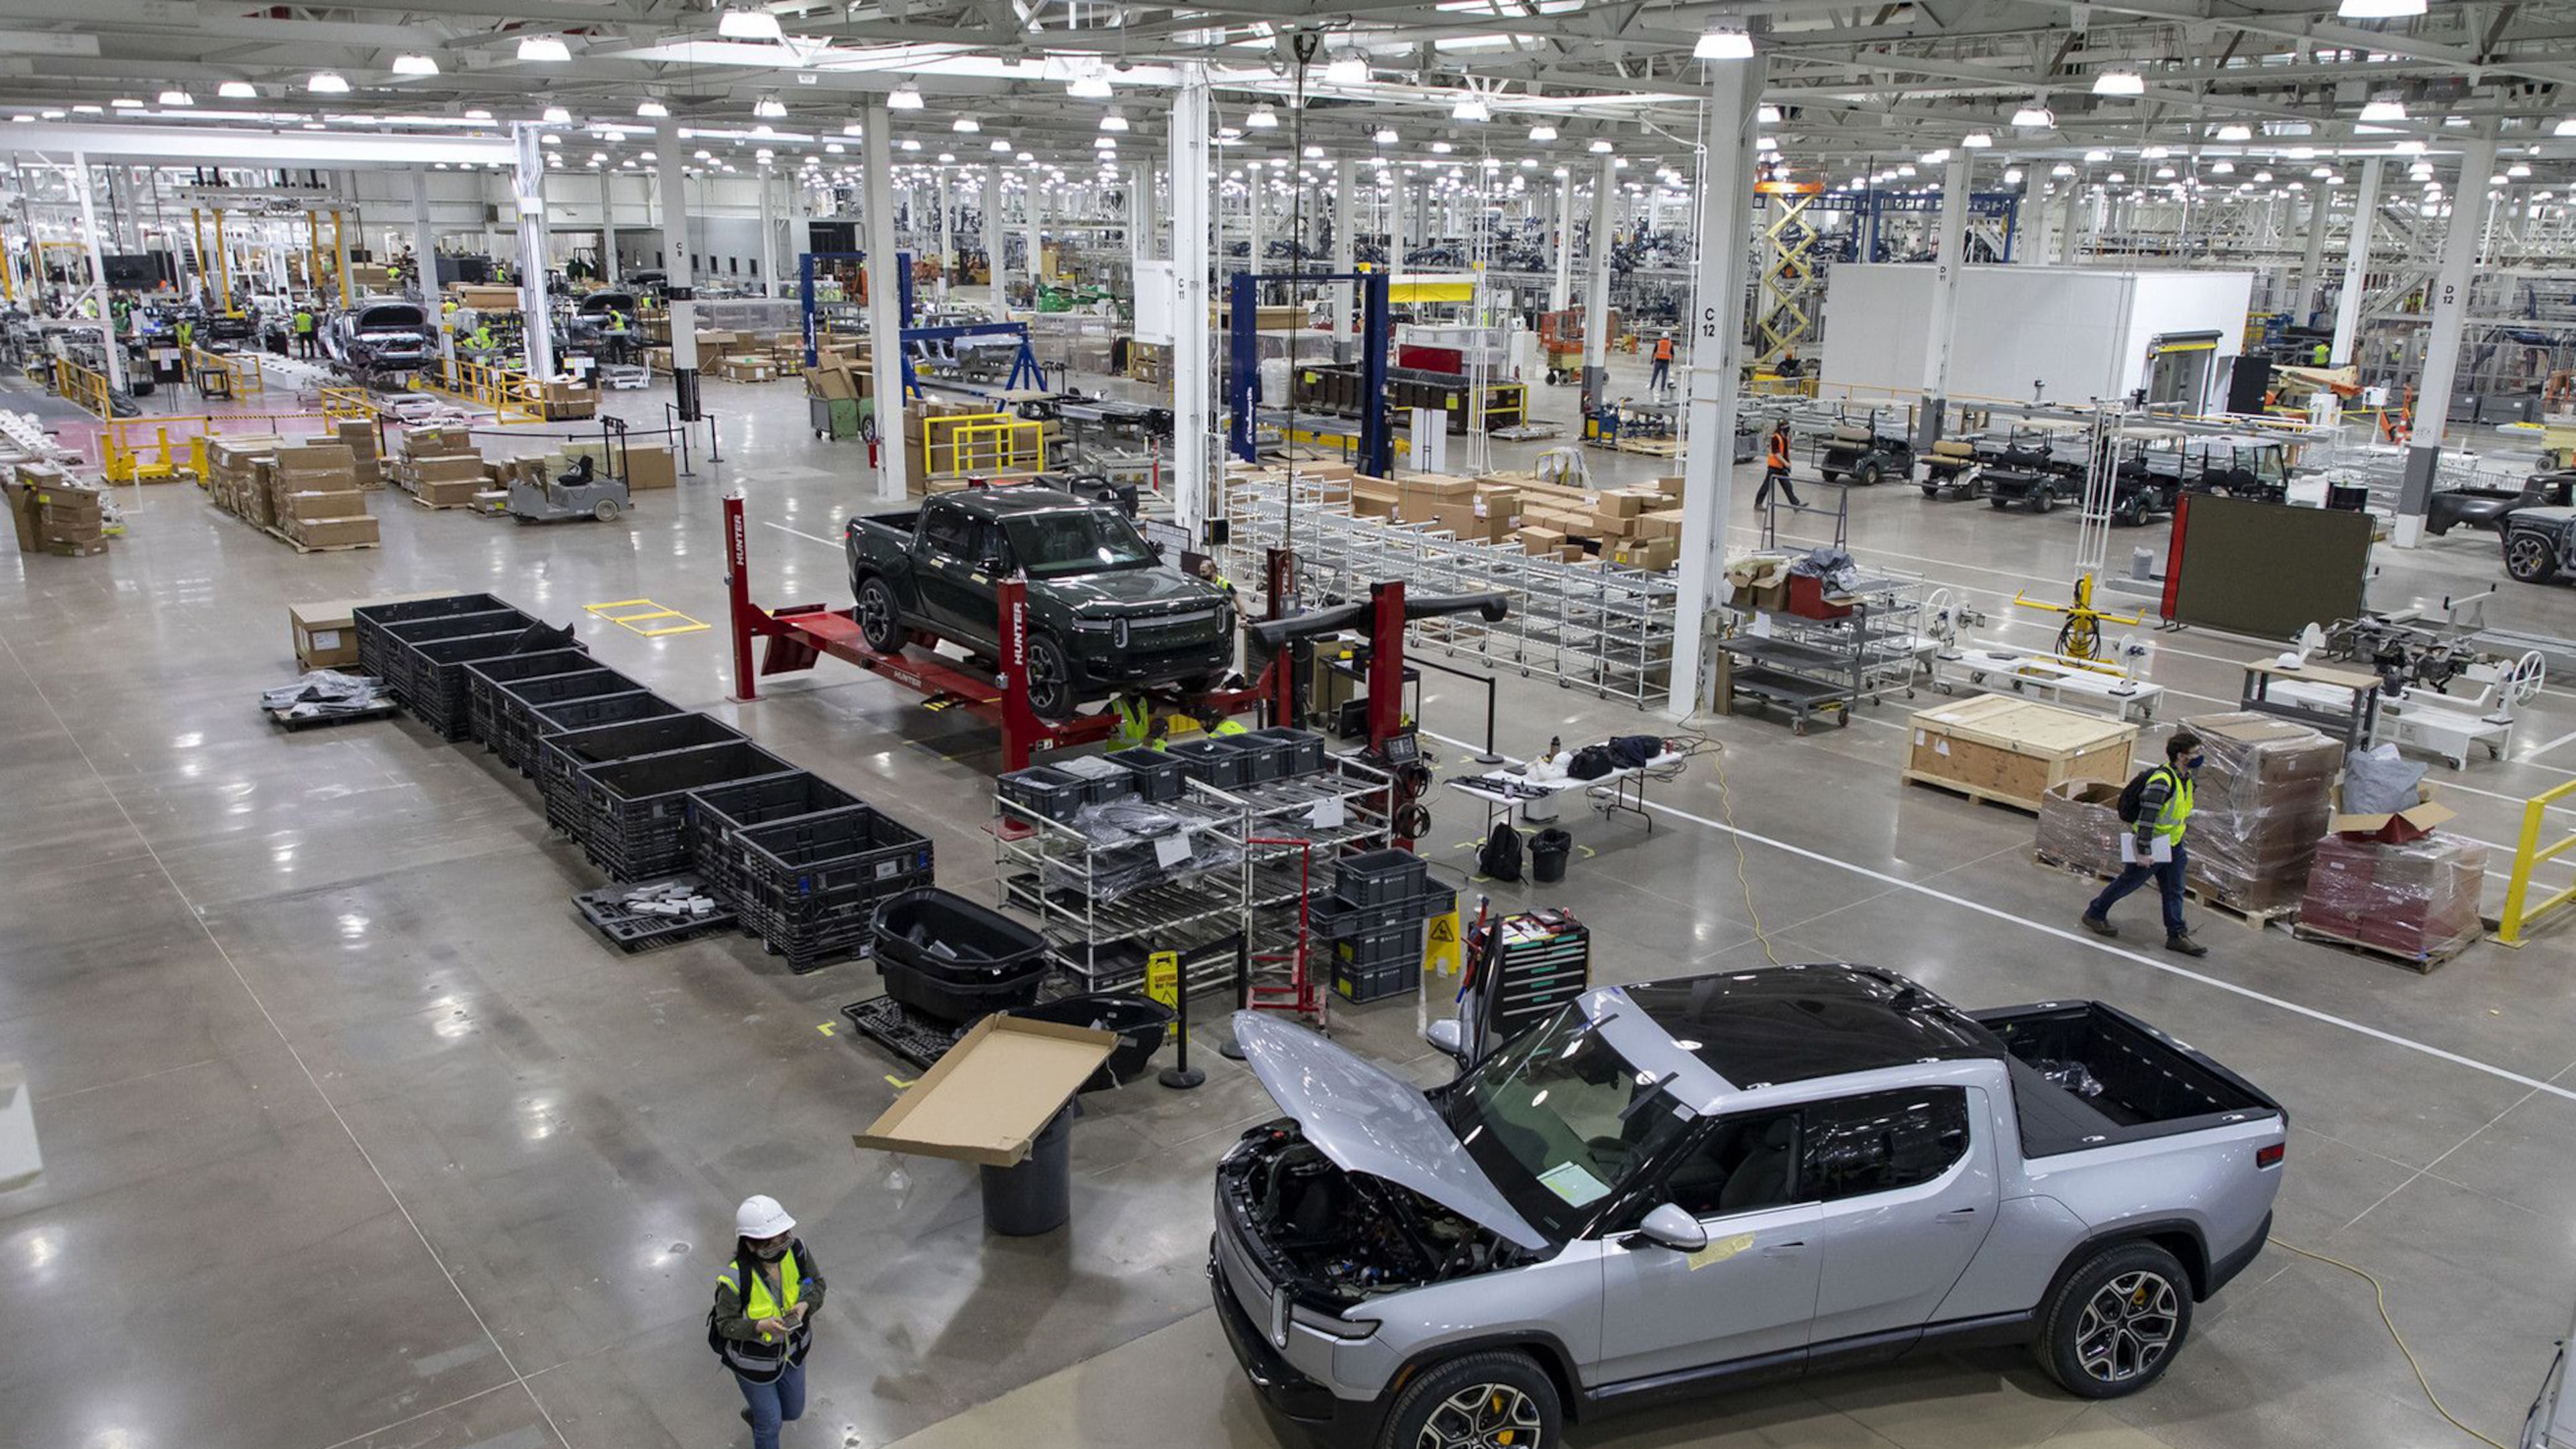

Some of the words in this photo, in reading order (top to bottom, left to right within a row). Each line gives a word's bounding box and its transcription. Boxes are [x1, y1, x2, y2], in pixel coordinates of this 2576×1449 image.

[1178, 278, 1184, 288] C
[1178, 290, 1185, 300] 11
[2445, 285, 2454, 294] D
[2443, 295, 2454, 304] 12
[1705, 307, 1715, 321] C
[1703, 324, 1715, 337] 12
[733, 514, 744, 566] HUNTER
[1013, 601, 1023, 665] HUNTER
